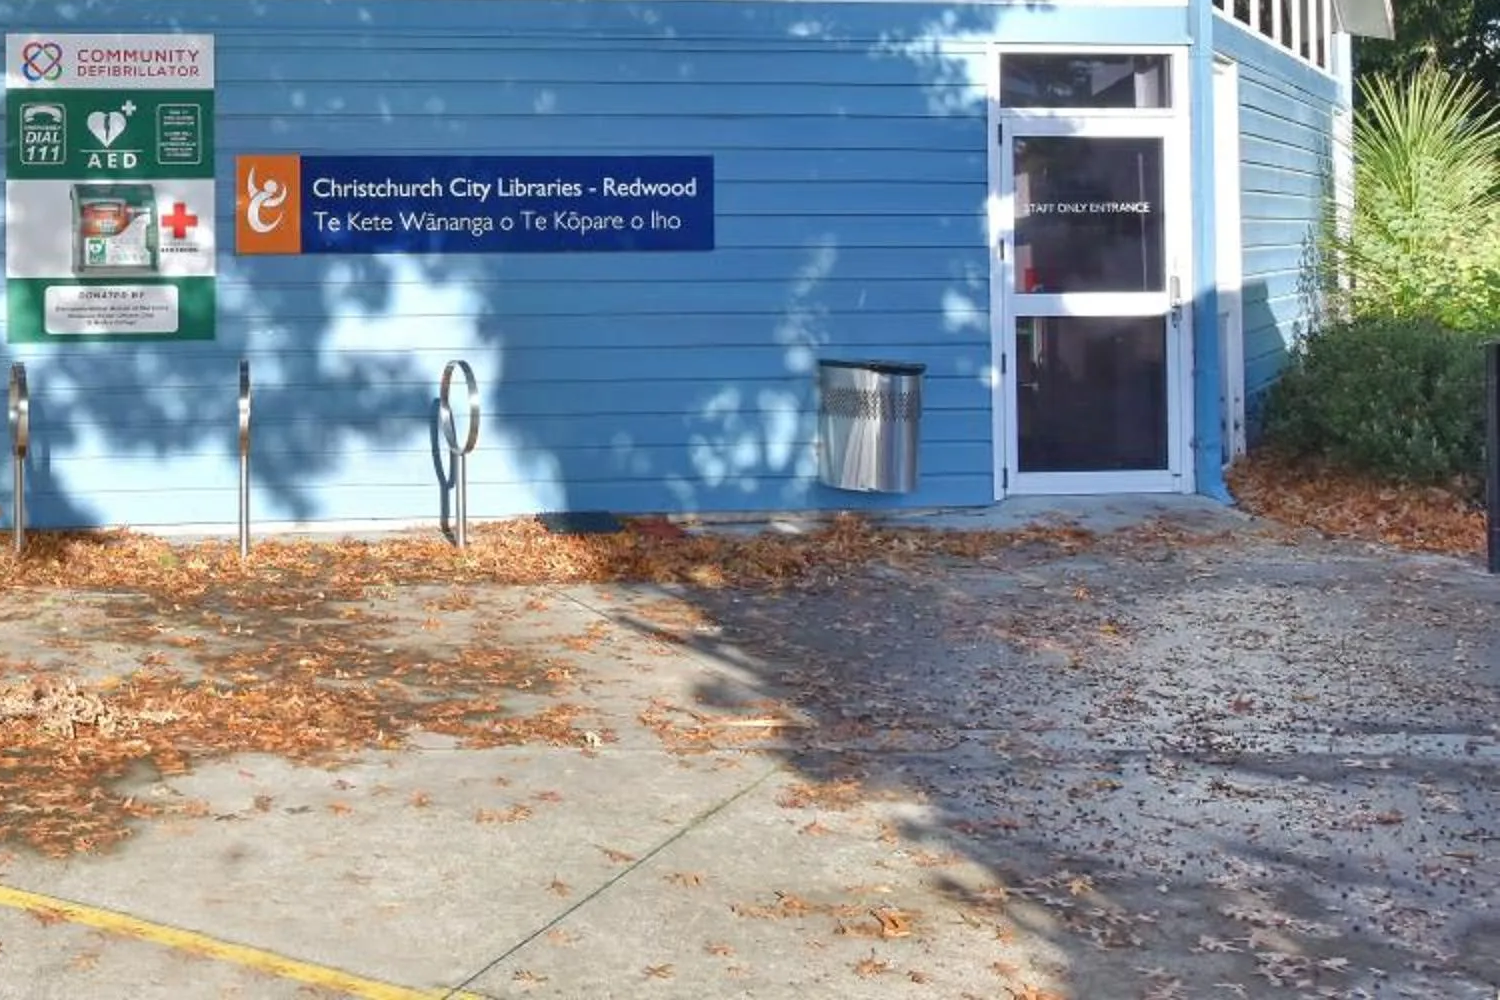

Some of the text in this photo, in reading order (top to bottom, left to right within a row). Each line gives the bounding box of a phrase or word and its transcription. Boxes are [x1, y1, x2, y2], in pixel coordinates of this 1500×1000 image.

[77, 49, 199, 62] COMMUNITY
[77, 65, 199, 77] DEFIBRILLATOR
[25, 131, 61, 143] DIAL
[26, 146, 60, 161] 111
[87, 154, 137, 169] AED
[312, 177, 443, 198] Christchurch
[450, 177, 492, 203] City
[497, 177, 583, 197] Libraries
[603, 177, 697, 197] Redwood
[1057, 203, 1088, 213] ONLY
[1089, 201, 1151, 213] ENTRANCE
[312, 209, 682, 237] Te Kete Wānanga o Te Kōpare o Iho
